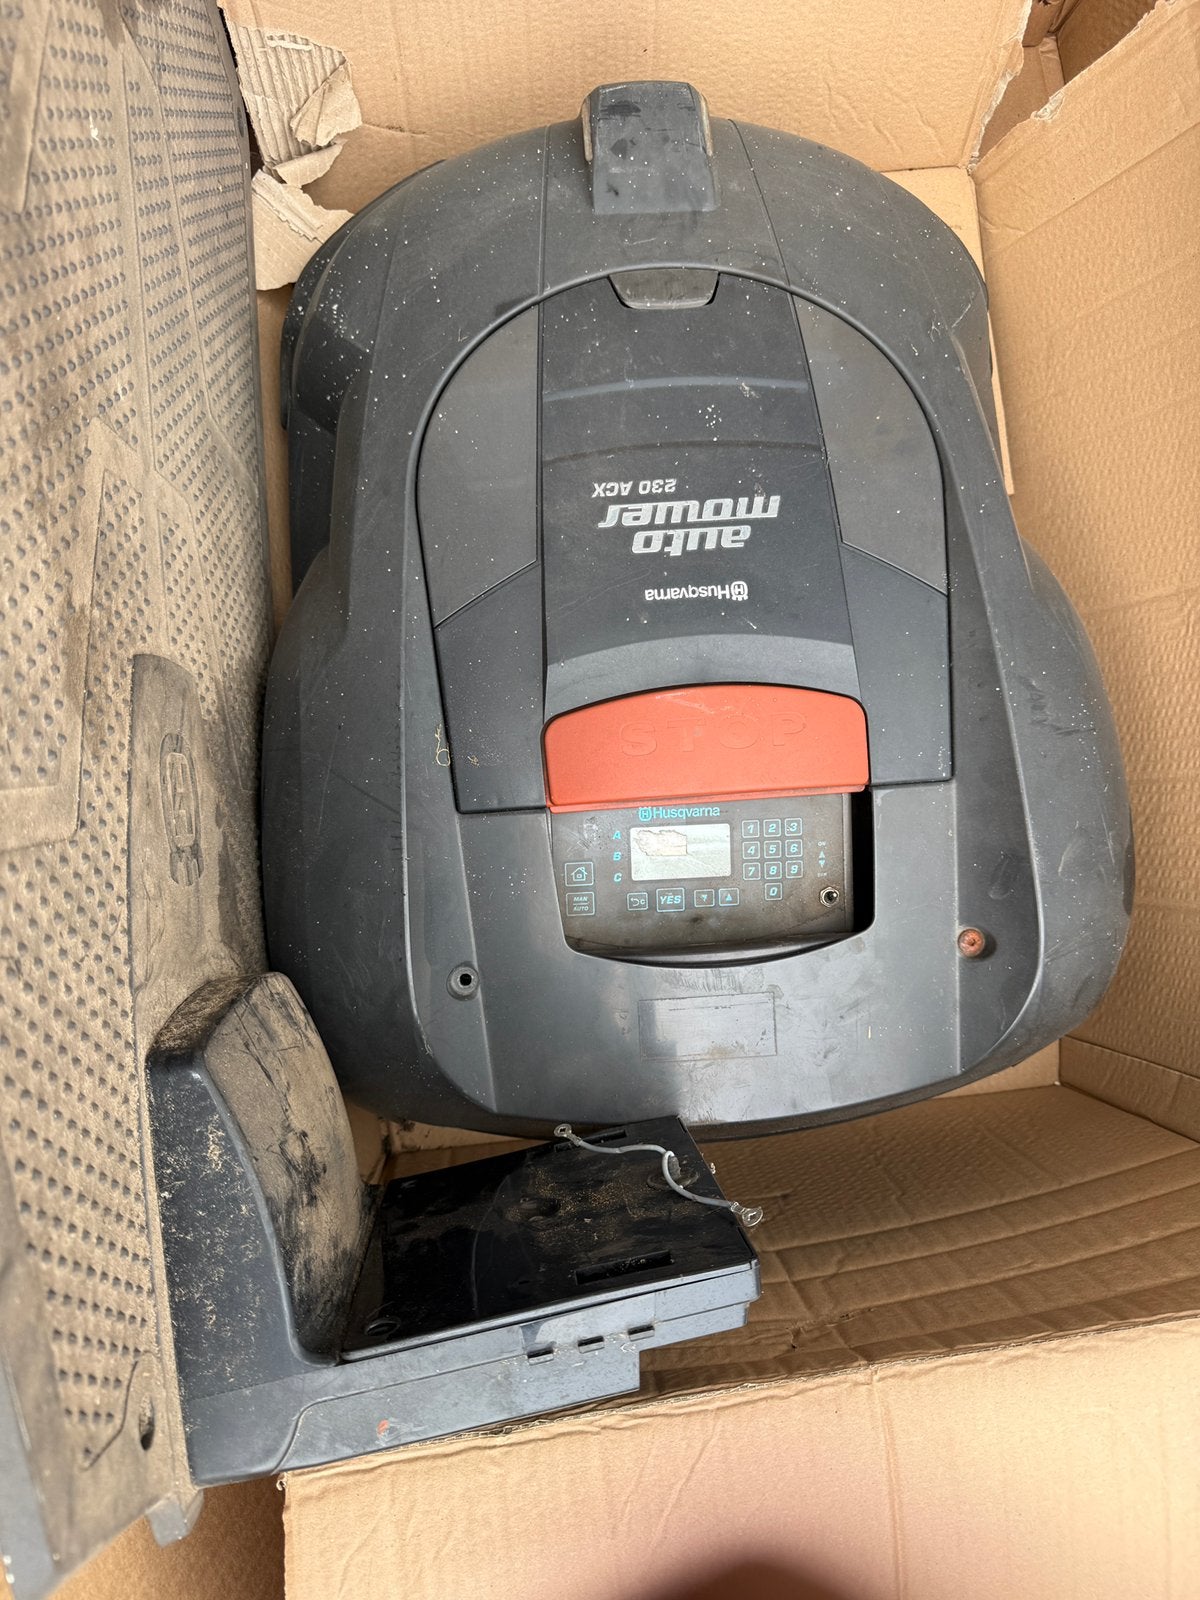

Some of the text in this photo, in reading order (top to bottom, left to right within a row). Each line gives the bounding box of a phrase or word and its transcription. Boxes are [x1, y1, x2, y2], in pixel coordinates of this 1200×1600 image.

[591, 478, 677, 498] 230 ACX
[598, 495, 781, 528] mower
[632, 525, 751, 556] auto
[645, 584, 730, 601] Husqvarna
[619, 711, 807, 757] STOP
[653, 806, 720, 819] Husqvarna
[768, 823, 776, 833] 2
[789, 822, 798, 832] 3
[613, 830, 621, 840] A
[747, 845, 756, 855] 4
[769, 844, 777, 854] 5
[790, 843, 798, 853] 6
[613, 851, 622, 861] B
[748, 866, 755, 876] 7
[769, 865, 777, 875] 8
[790, 864, 798, 874] 9
[613, 872, 622, 882] C
[769, 887, 778, 896] 0
[660, 895, 681, 905] YES
